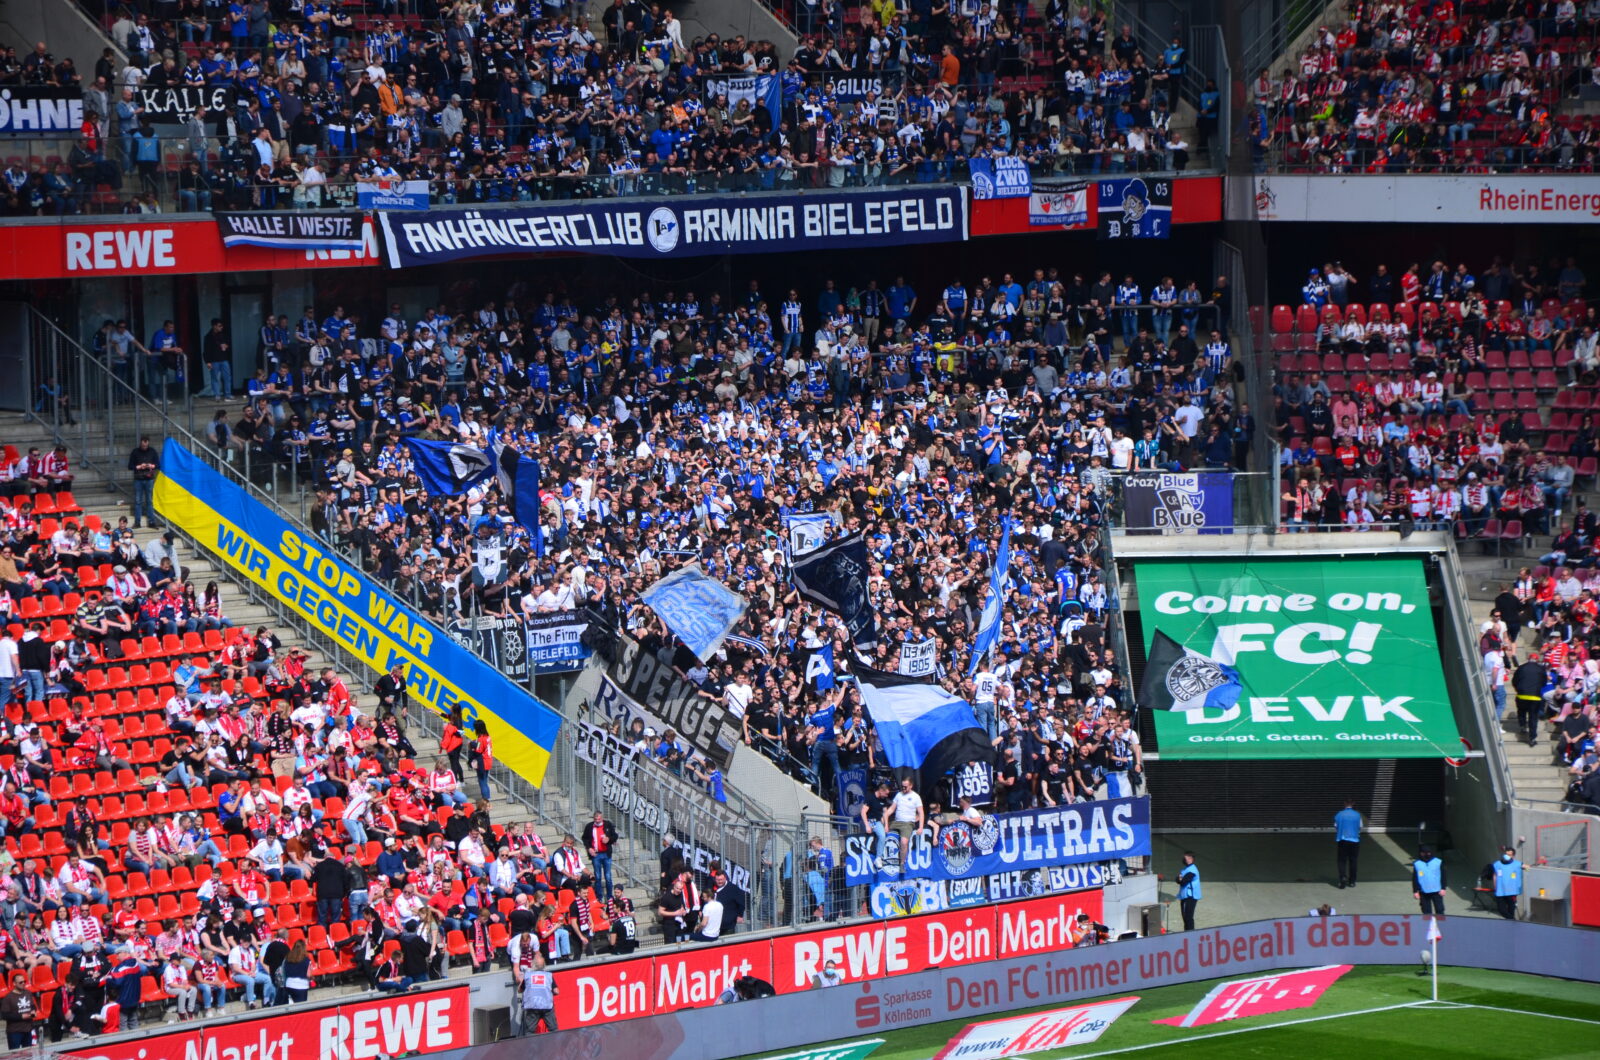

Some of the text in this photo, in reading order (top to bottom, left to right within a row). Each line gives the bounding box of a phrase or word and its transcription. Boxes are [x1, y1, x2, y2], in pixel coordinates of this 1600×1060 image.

[142, 88, 226, 112] KALLE
[996, 170, 1028, 187] ZWO
[1102, 184, 1114, 197] 19
[1155, 182, 1168, 196] 05
[227, 215, 285, 235] HALLE
[298, 216, 353, 237] WESTF.
[403, 211, 644, 254] ANHÄNGERCLUB
[683, 205, 795, 244] ARMINIA
[804, 197, 954, 237] BIELEFELD
[66, 229, 176, 270] REWE
[1125, 476, 1161, 490] Crazy
[1164, 475, 1195, 487] Blue
[279, 530, 434, 657] STOP WAR
[1154, 591, 1416, 615] Come on,
[217, 523, 478, 732] WIR GEGEN KRIEG
[532, 629, 578, 645] The Firm
[531, 645, 579, 660] BIELEFELD
[1211, 621, 1383, 666] FC!
[909, 658, 930, 673] 1905
[616, 641, 725, 751] SPENGE
[982, 681, 993, 692] 05
[1186, 696, 1423, 725] DEVK
[1188, 732, 1428, 743] Gesagt. Getan. Geholfen.
[576, 722, 641, 782] PORTA
[843, 772, 863, 782] ULTRAS
[958, 776, 990, 798] 1905
[673, 808, 690, 828] ON
[846, 803, 1135, 877] SK 05 ULTRAS
[989, 871, 1022, 899] 647
[1050, 863, 1102, 889] BOYS
[623, 921, 635, 937] 19
[577, 971, 646, 1022] Dein
[794, 926, 908, 987] REWE
[927, 918, 990, 965] Dein
[947, 915, 1412, 1013] Den FC immer und überall dabei
[883, 988, 933, 1009] Sparkasse
[885, 1007, 932, 1025] KölnBonn
[319, 997, 453, 1060] REWE
